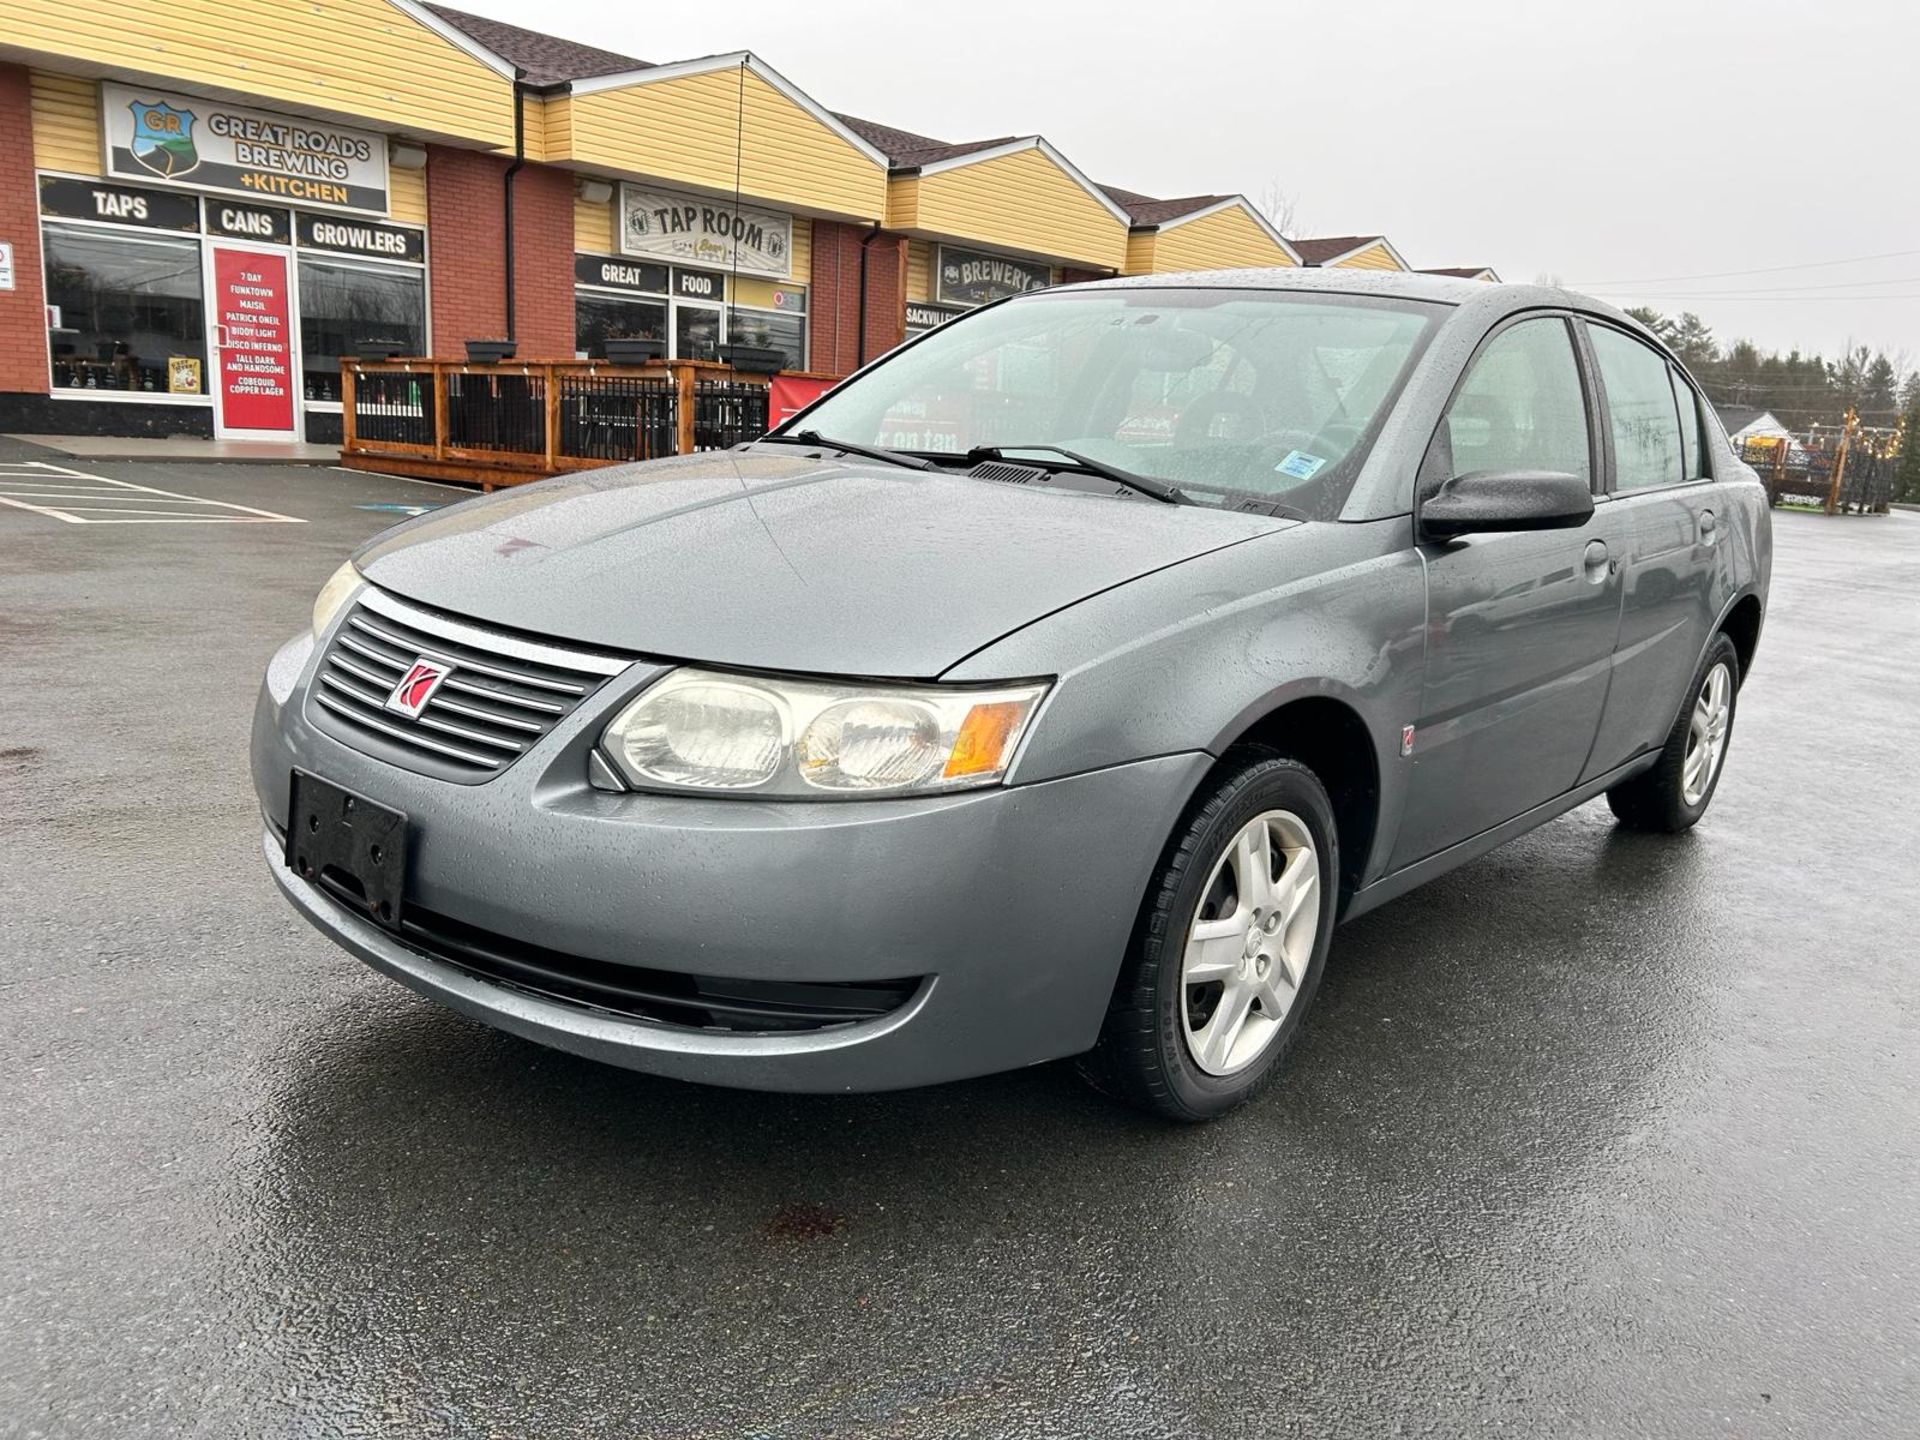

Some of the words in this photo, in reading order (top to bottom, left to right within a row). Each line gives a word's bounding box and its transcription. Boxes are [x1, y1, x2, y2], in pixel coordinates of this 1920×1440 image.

[143, 110, 183, 136] GR
[208, 113, 289, 147] GREAT
[292, 127, 371, 161] ROADS
[235, 141, 349, 180] BREWING
[240, 174, 348, 204] +KITCHEN
[92, 191, 148, 220] TAPS
[220, 208, 273, 237] CANS
[654, 207, 697, 234] TAP
[702, 208, 763, 251] ROOM
[312, 222, 406, 254] GROWLERS
[247, 273, 262, 282] DAY
[601, 264, 641, 286] GREAT
[682, 275, 711, 295] FOOD
[961, 261, 1031, 291] BREWERY
[230, 285, 273, 297] FUNKTOWN
[226, 312, 257, 323] PATRICK
[255, 329, 276, 338] LIGHT
[251, 342, 282, 352] INFERNO
[227, 362, 243, 371] AND
[244, 364, 285, 374] HANDSOME
[236, 354, 253, 363] TALL
[255, 356, 275, 365] DARK
[230, 385, 259, 394] COPPER
[261, 387, 284, 396] LAGER
